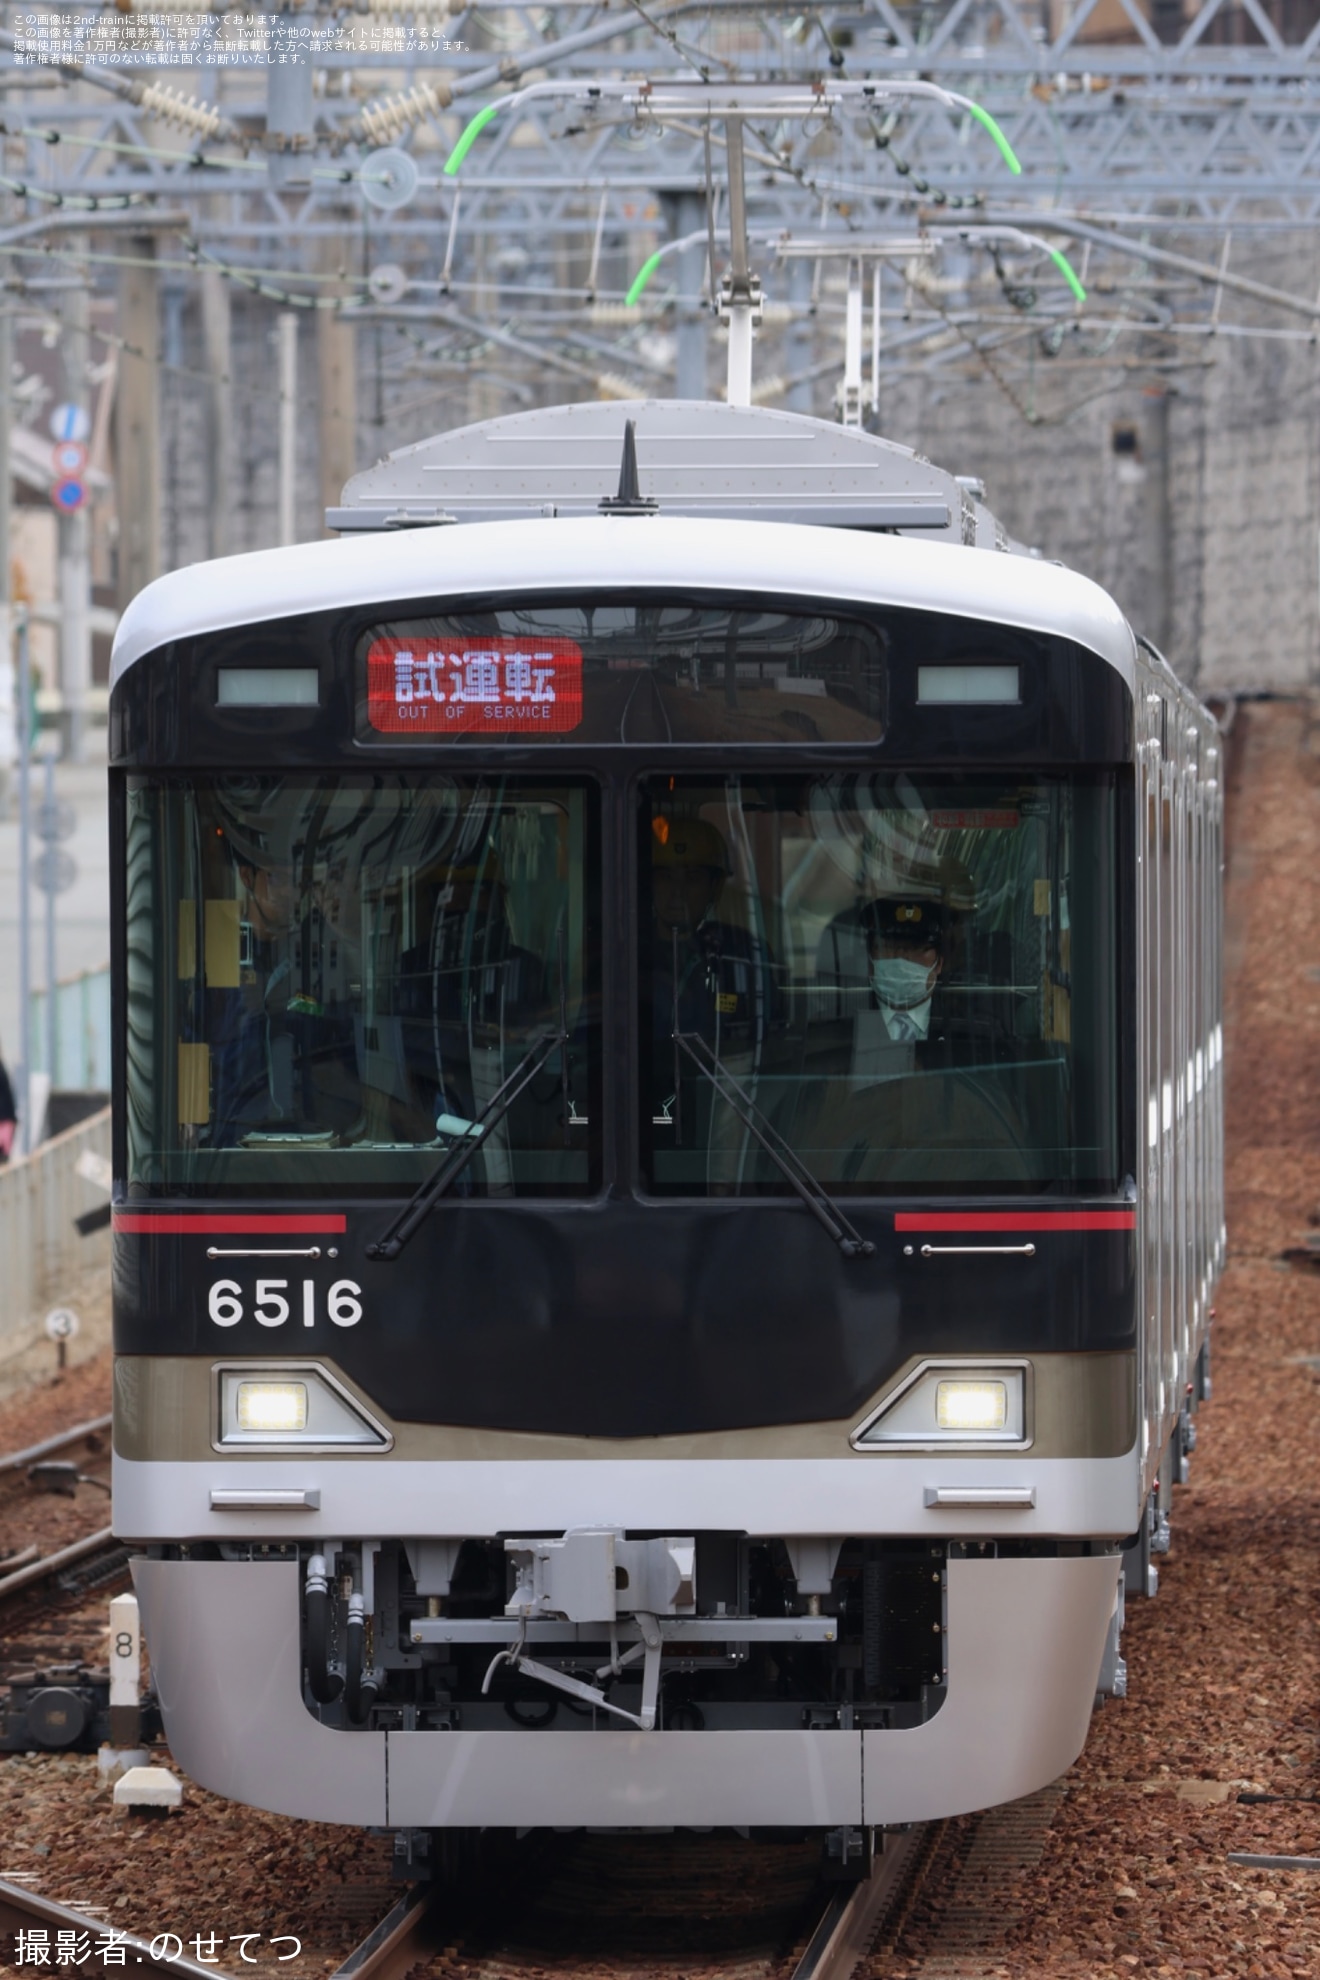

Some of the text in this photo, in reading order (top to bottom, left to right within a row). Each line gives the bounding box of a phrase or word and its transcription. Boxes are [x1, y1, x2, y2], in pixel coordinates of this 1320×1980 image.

[394, 651, 556, 702] 試運転
[398, 705, 551, 719] OUT OF SERVICE
[208, 1279, 363, 1328] 6516
[115, 1632, 132, 1659] 8
